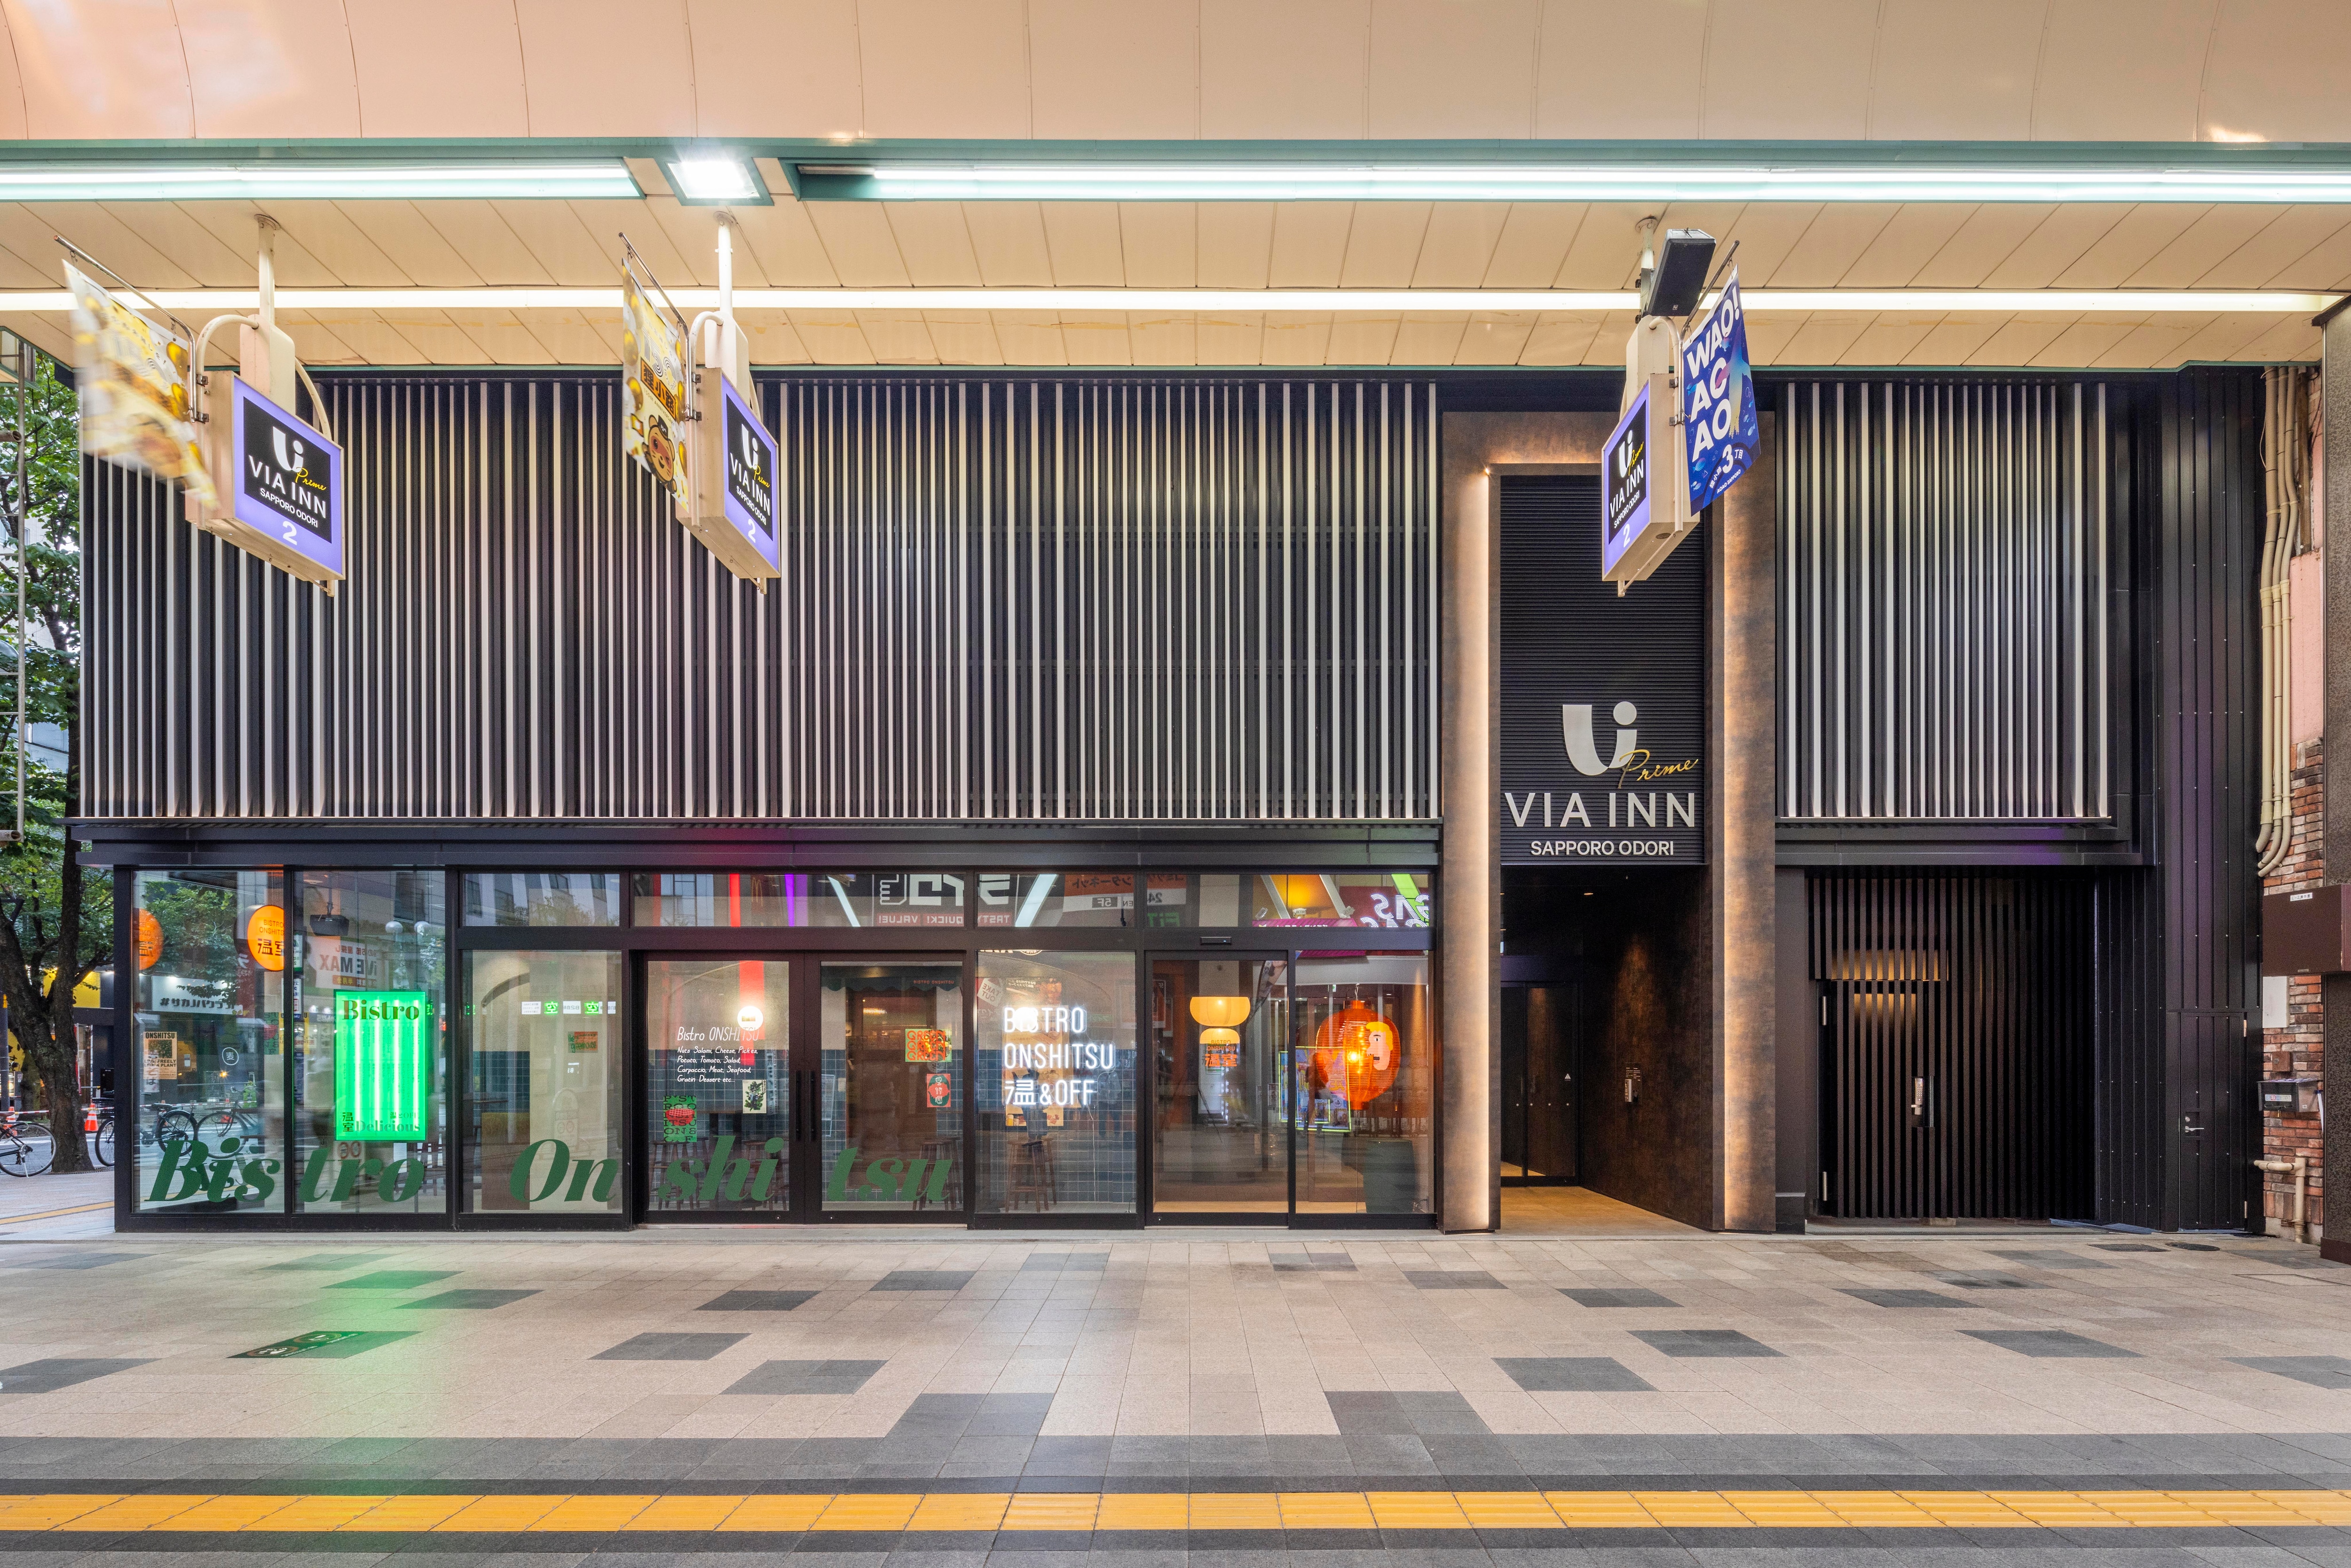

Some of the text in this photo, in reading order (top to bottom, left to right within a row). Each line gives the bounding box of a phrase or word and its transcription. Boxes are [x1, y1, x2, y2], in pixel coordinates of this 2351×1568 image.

[1687, 285, 1739, 379] WAO!
[644, 363, 674, 415] 狸小路
[1692, 399, 1731, 463] AO
[1628, 441, 1644, 476] Prime
[249, 455, 326, 519] VIA INN
[296, 467, 326, 490] Prime
[730, 453, 770, 516] VIA INN
[754, 465, 770, 488] Prime
[1610, 459, 1643, 518] VIA INN
[260, 488, 318, 528] SAPPORO ODORI
[736, 486, 766, 525] SAPPORO ODORI
[1614, 490, 1640, 528] SAPPORO ODORI
[283, 520, 297, 545] 2
[748, 519, 756, 543] 2
[1623, 524, 1630, 548] 2
[1617, 749, 1698, 789] Prime
[1505, 793, 1695, 827] VIA INN
[1531, 841, 1673, 855] SAPPORO ODORI
[259, 927, 284, 936] ONSHITS
[342, 1000, 419, 1020] Bistro
[677, 1026, 760, 1041] Bistro ONSHITSU
[1004, 1043, 1113, 1069] ONSHITSU
[1205, 1054, 1237, 1066] 温室
[677, 1065, 706, 1074] Carpaccio,
[726, 1065, 751, 1075] Seafood,
[356, 1120, 420, 1132] Delicious
